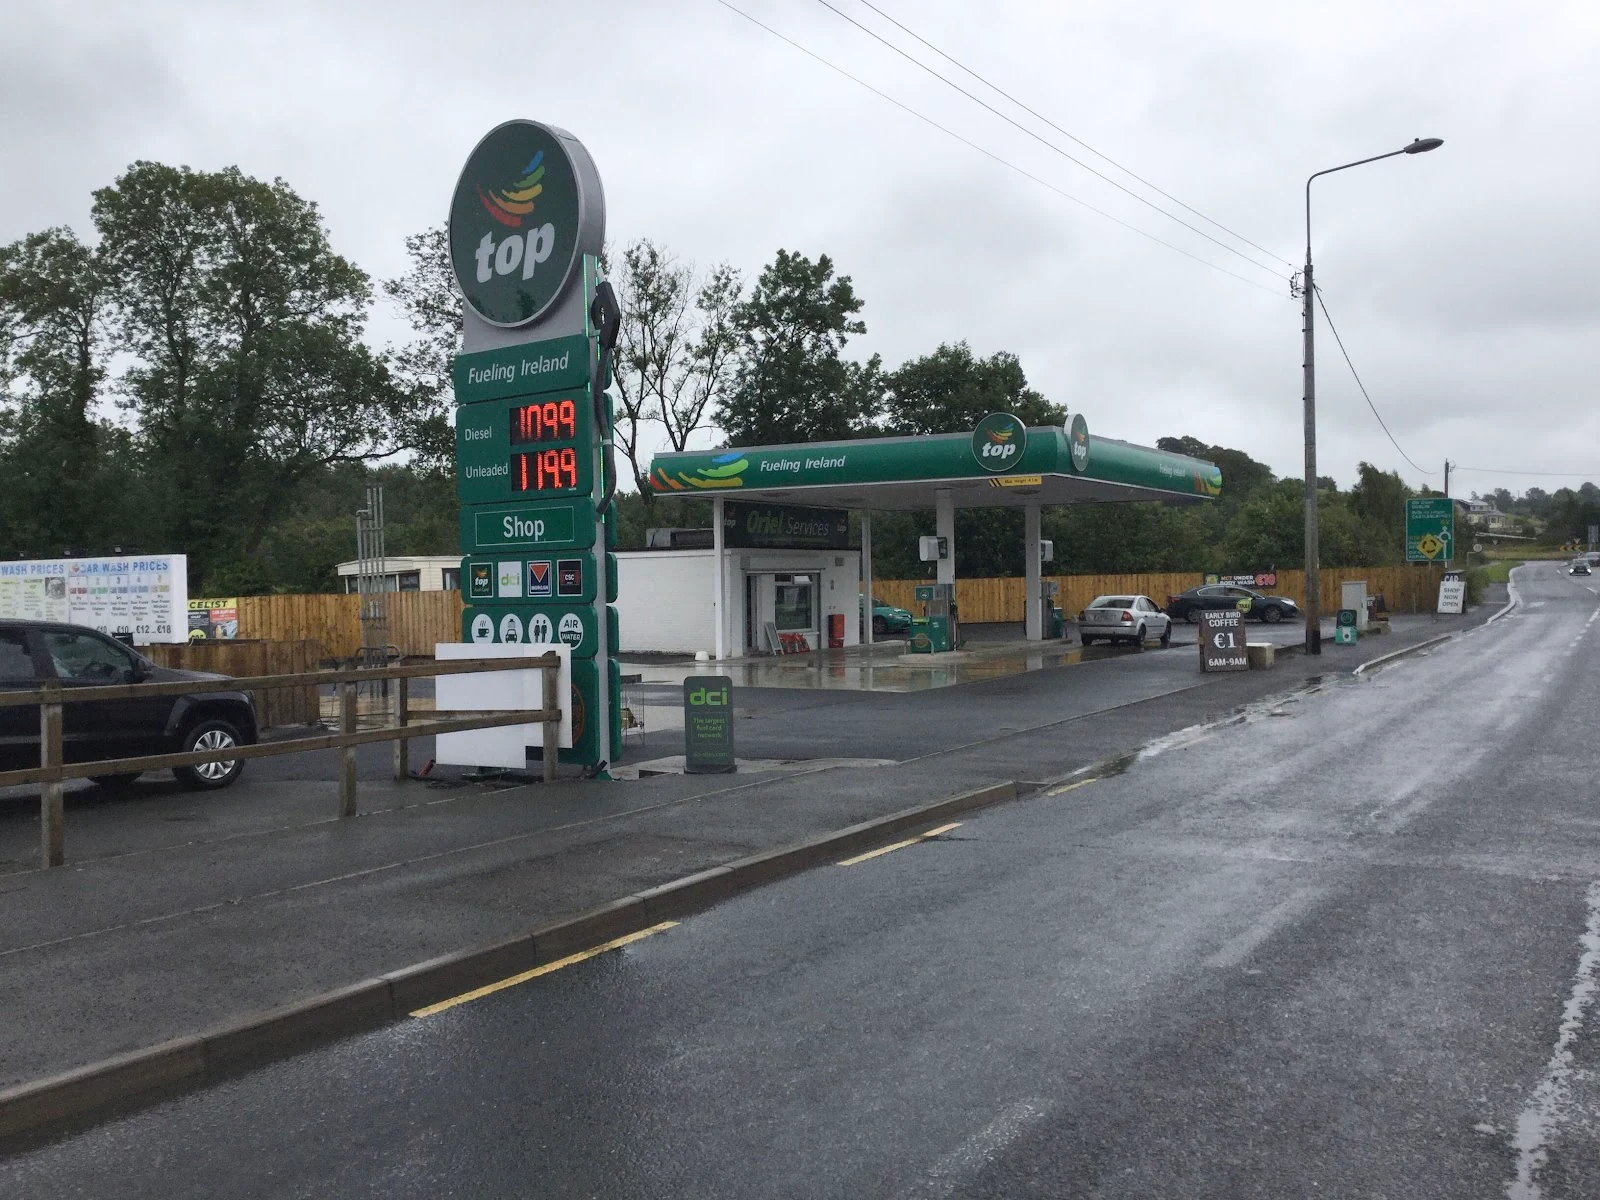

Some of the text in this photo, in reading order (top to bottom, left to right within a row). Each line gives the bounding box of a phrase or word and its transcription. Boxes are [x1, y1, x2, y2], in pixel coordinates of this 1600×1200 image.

[475, 222, 555, 283] top
[468, 351, 569, 384] Fueling Ireland
[465, 426, 492, 441] Diesel
[982, 441, 1016, 459] top
[1073, 441, 1087, 459] top
[465, 462, 509, 479] Unleaded
[760, 456, 846, 473] Fueling Ireland
[503, 516, 544, 541] Shop
[746, 510, 829, 536] Oriel Services
[1, 564, 64, 576] WASH PRICES
[103, 562, 129, 573] WASH
[133, 561, 168, 571] PRICES
[475, 577, 489, 587] top
[1256, 574, 1276, 586] €10
[117, 625, 129, 633] €10
[136, 625, 150, 634] €12
[157, 625, 171, 634] €18
[564, 619, 579, 629] AIR
[1209, 618, 1239, 627] COFFEE
[1213, 632, 1237, 649] €1
[1208, 657, 1247, 666] 6AM-9AM
[689, 687, 728, 706] dci
